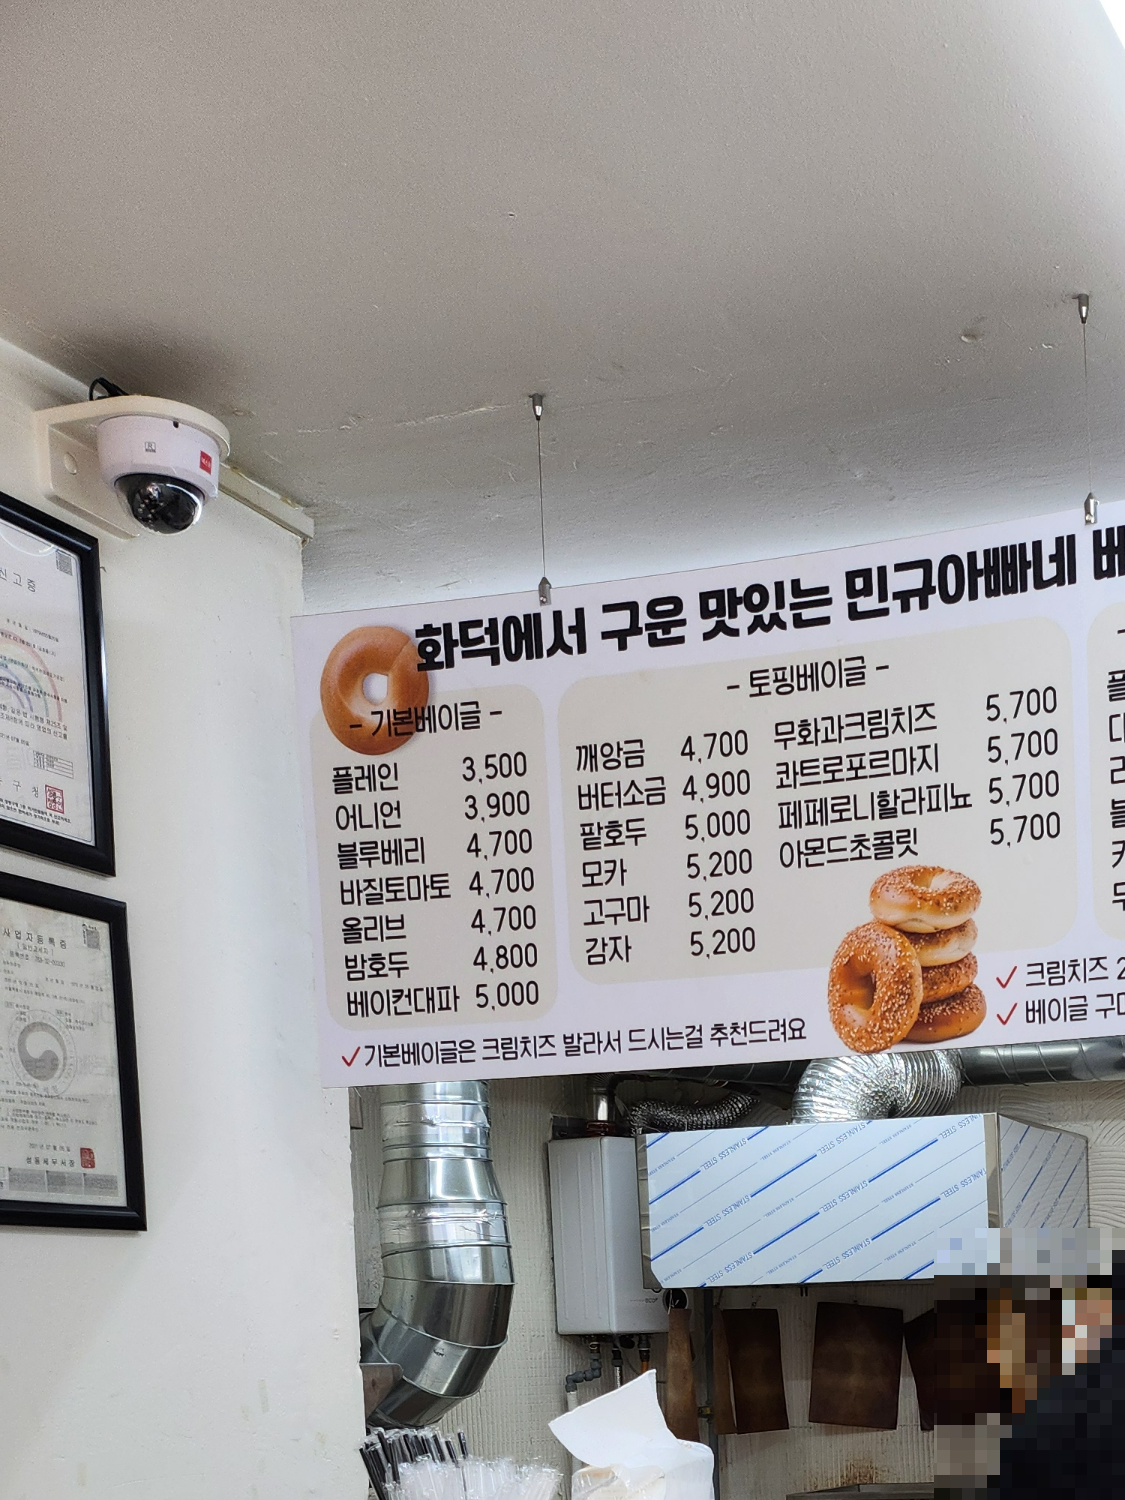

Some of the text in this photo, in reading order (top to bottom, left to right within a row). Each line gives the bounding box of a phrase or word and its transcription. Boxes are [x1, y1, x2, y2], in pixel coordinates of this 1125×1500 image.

[415, 607, 586, 669] 화덕에서
[601, 596, 687, 651] 구운
[699, 578, 832, 641] 맛있는
[845, 534, 1076, 621] 민규아빠네
[749, 656, 866, 697] 토핑베이글
[370, 700, 481, 738] 기본베이글
[774, 686, 1057, 750] 무화과크림치즈 5,700
[576, 730, 748, 772] 깨앙금 4,700
[776, 728, 1057, 789] 콰트로포르마지 5,700
[332, 752, 526, 794] 플레인 3,500
[578, 770, 750, 811] 버터소금 4,900
[336, 790, 529, 831] 어니언 3,900
[776, 770, 1059, 829] 페페로니할라피뇨 5,700
[580, 809, 750, 850] 팥호두 5,000
[780, 812, 1060, 871] 아몬드초콜릿 5,700
[338, 829, 532, 870] 블루베리 4,700
[582, 849, 752, 887] 모카 5,200
[340, 867, 534, 906] 바질토마토 4,700
[342, 905, 536, 944] 올리브 4,700
[584, 888, 754, 925] 고구마 5,200
[345, 943, 537, 981] 밤호두 4,800
[586, 927, 755, 965] 감자 5,200
[1026, 957, 1108, 986] 크림치즈
[347, 981, 538, 1017] 베이컨대파 5,000
[1026, 996, 1088, 1024] 베이글
[365, 1018, 806, 1067] 기본베이글은 크림치즈 발라서 드시는걸 추천드려요
[818, 1121, 866, 1155] STAINLESS STEEL
[939, 1125, 957, 1140] STEEL
[701, 1137, 747, 1171] STAINLESS STEEL
[820, 1180, 868, 1213] STAINLESS STEEL
[940, 1184, 960, 1198] STEEL
[703, 1194, 750, 1227] STAINLESS STEEL
[707, 1251, 753, 1284] STAINLESS STEEL
[823, 1237, 871, 1270] STAINLESS STEEL
